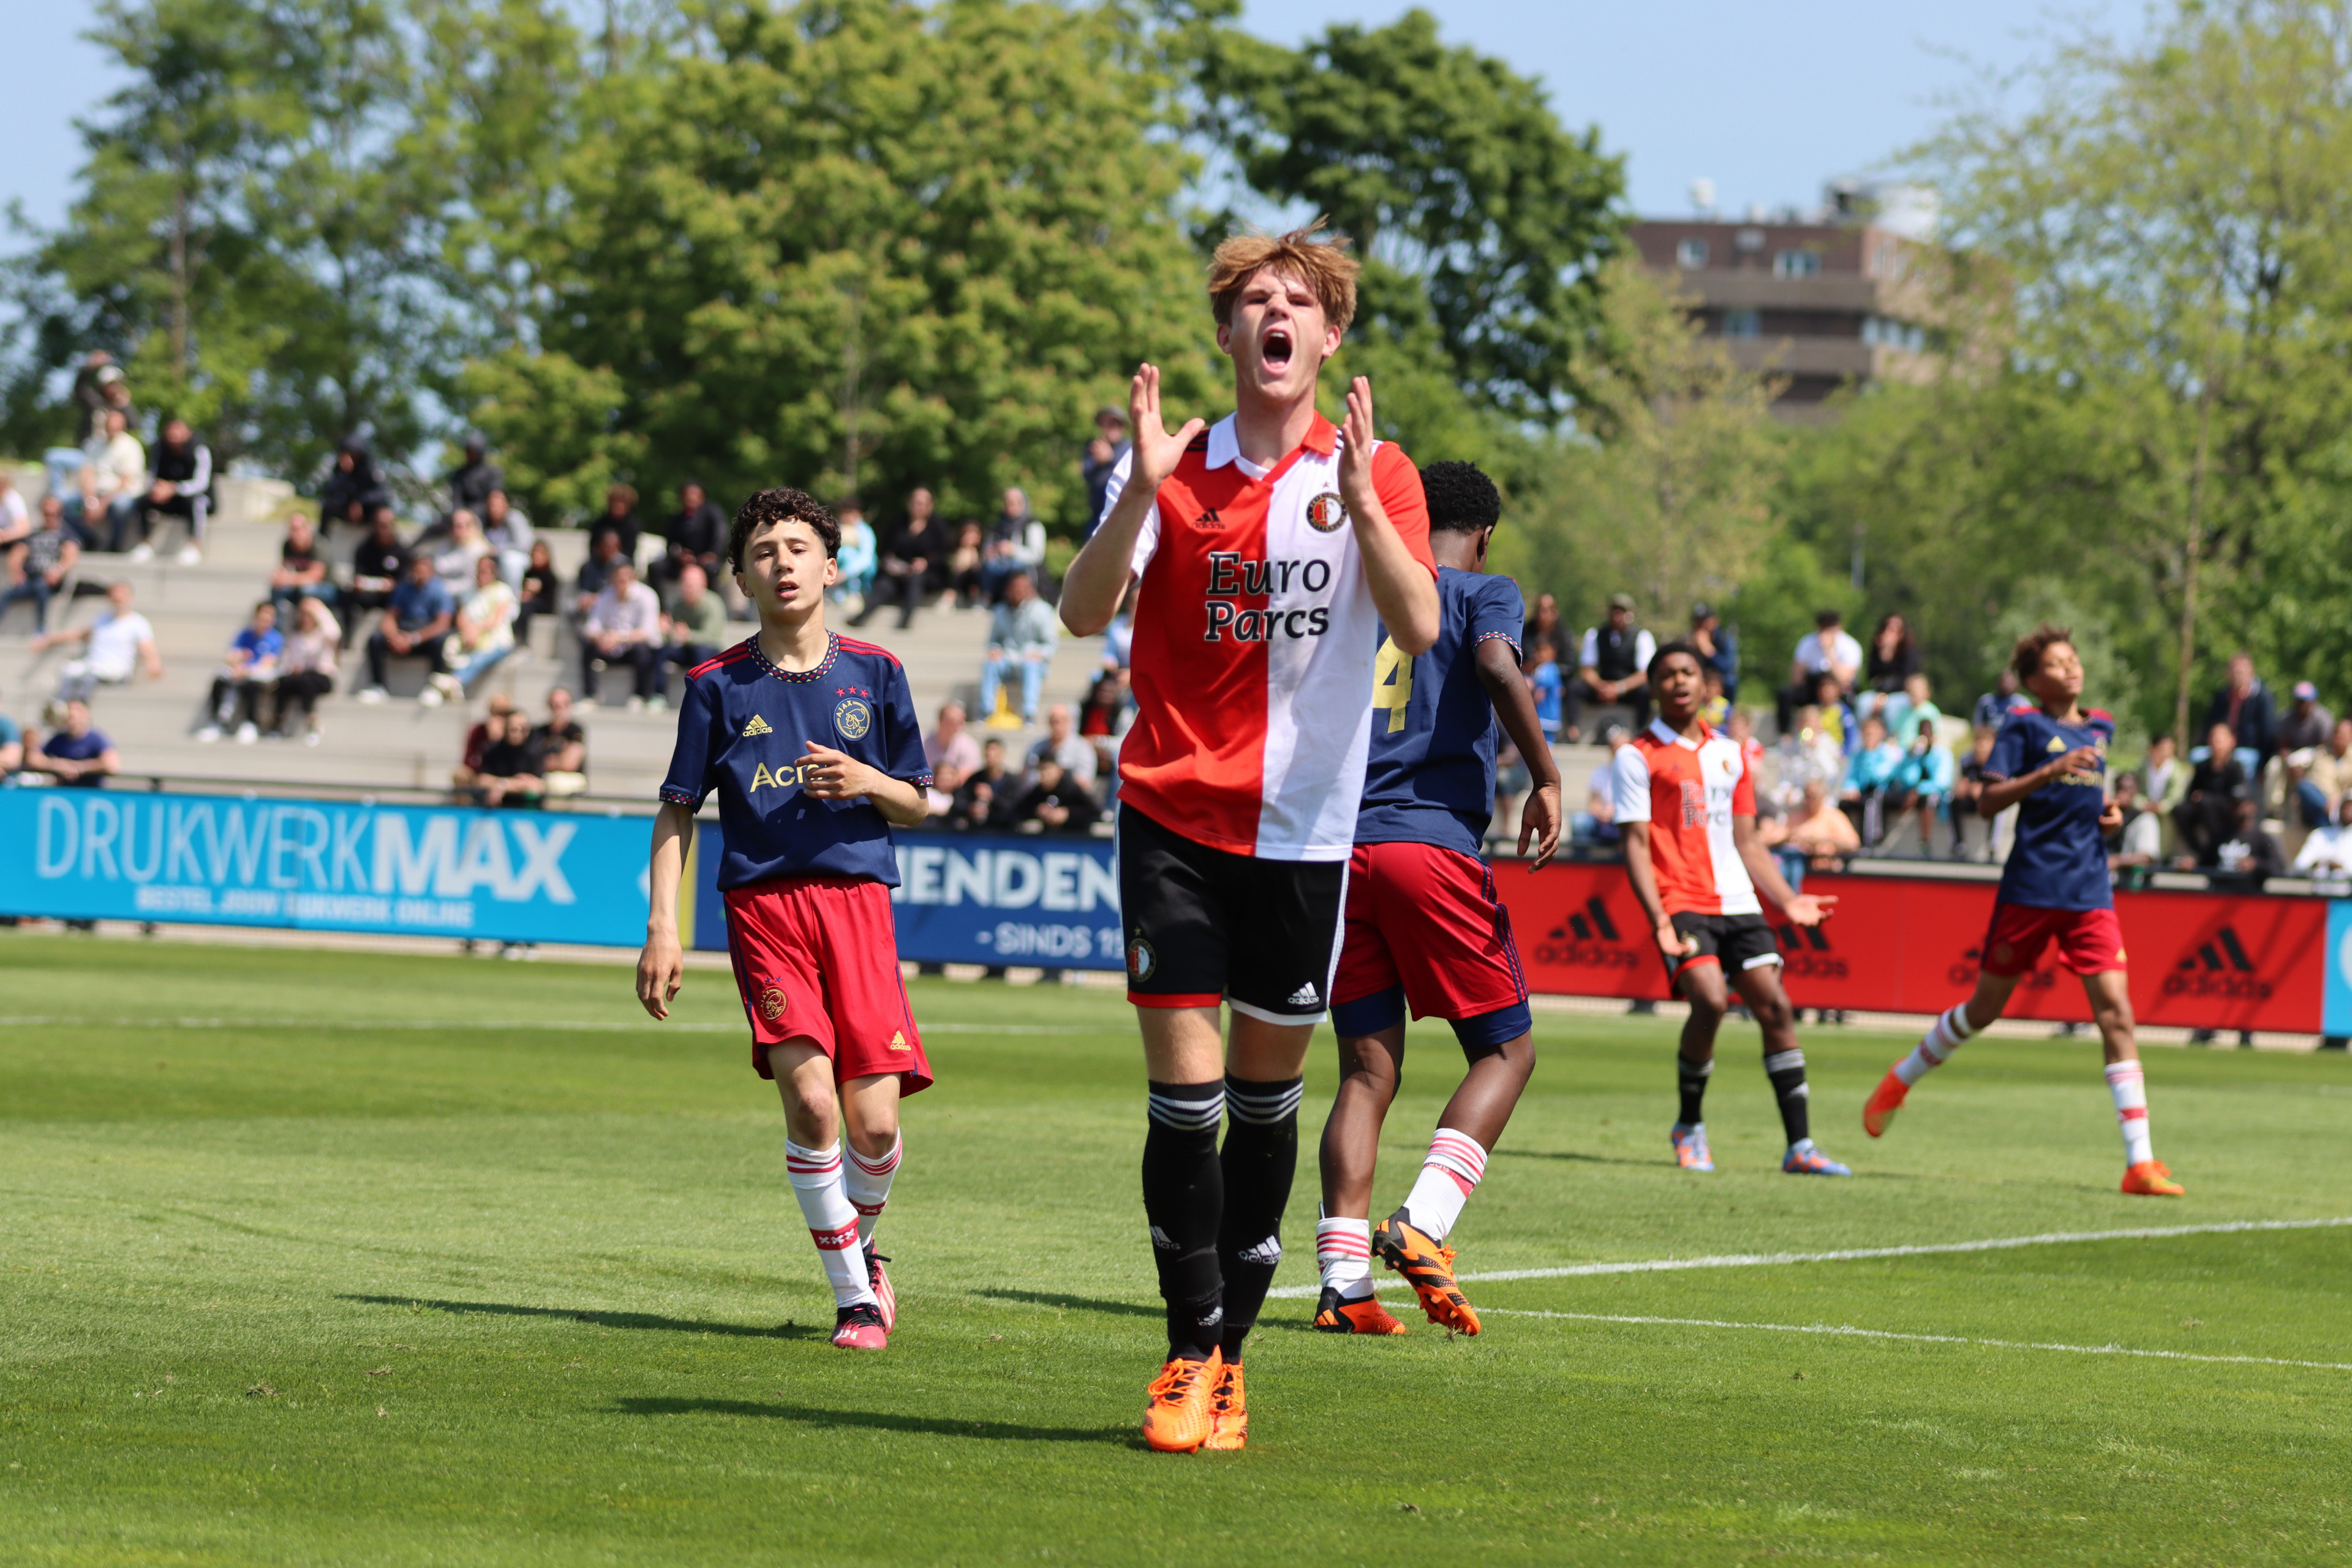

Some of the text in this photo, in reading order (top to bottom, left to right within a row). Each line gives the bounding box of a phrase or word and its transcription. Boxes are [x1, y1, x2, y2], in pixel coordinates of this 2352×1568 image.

[1191, 521, 1226, 530] adidas
[1206, 551, 1332, 595] Euro
[1204, 600, 1330, 642] Parcs
[1372, 633, 1414, 734] 4
[836, 700, 853, 718] AJAX
[742, 726, 773, 737] adidas
[750, 762, 827, 793] Acr
[36, 794, 579, 905] DRUKWERKMAX
[995, 921, 1092, 959] SINDS
[1287, 996, 1320, 1005] adidas
